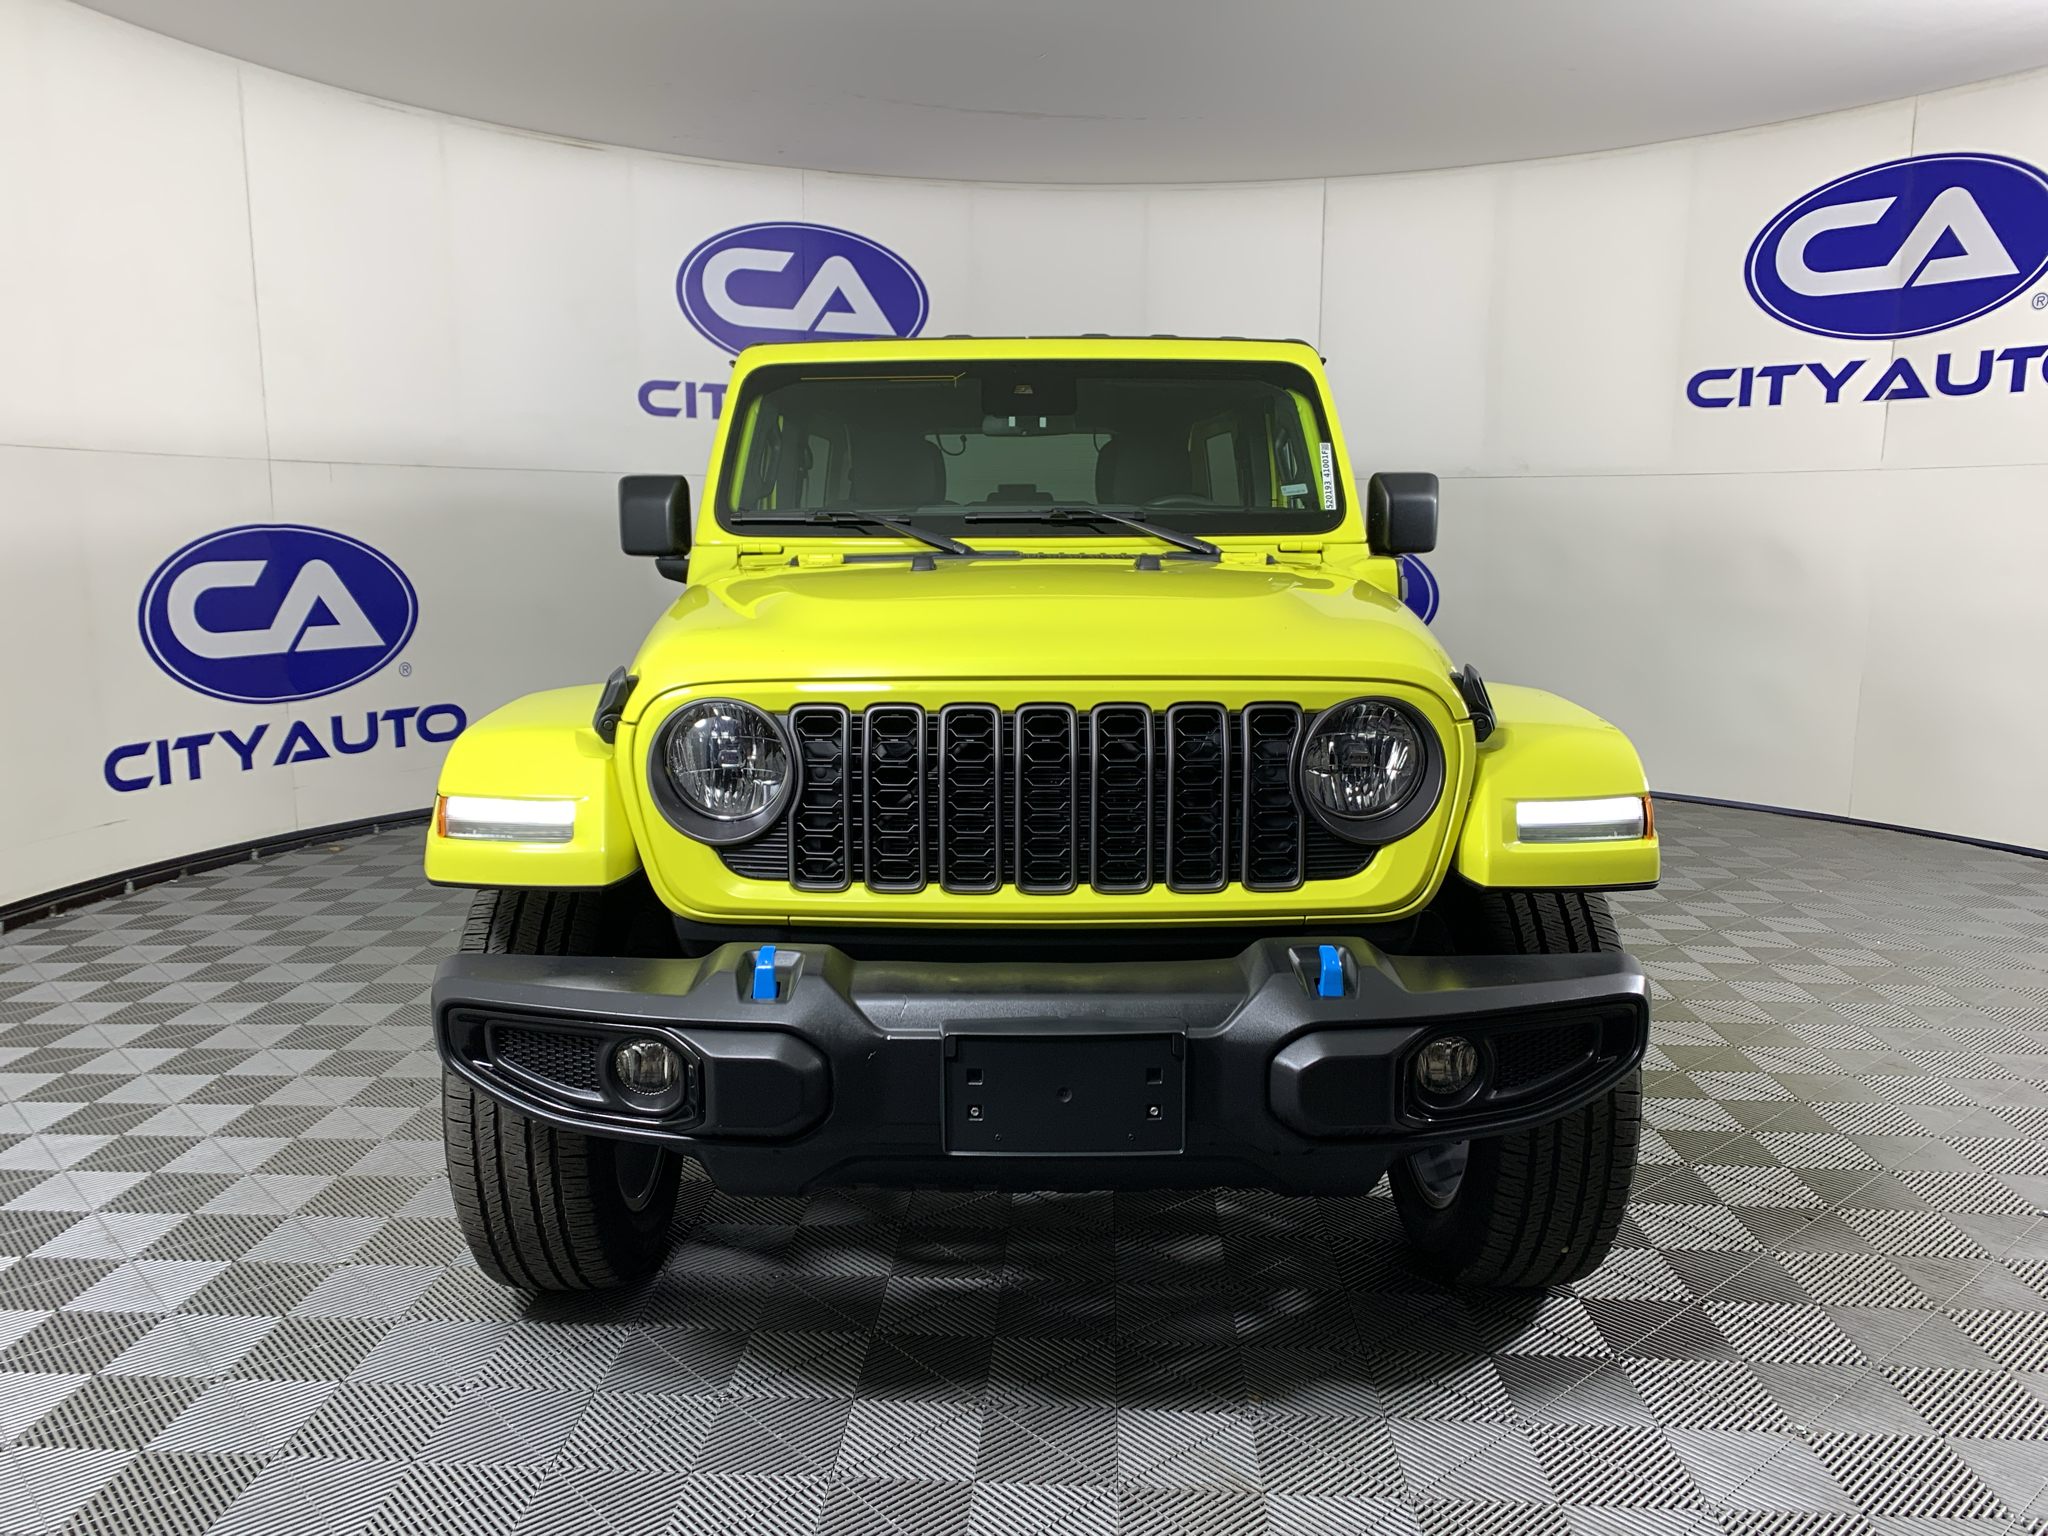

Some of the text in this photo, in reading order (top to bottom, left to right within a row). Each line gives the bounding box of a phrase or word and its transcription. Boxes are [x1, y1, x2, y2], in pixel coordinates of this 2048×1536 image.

[1775, 185, 2021, 297] CA
[702, 247, 898, 336] CA
[637, 379, 728, 420] CIT
[1862, 344, 2048, 402] AUT
[167, 558, 386, 660] CA
